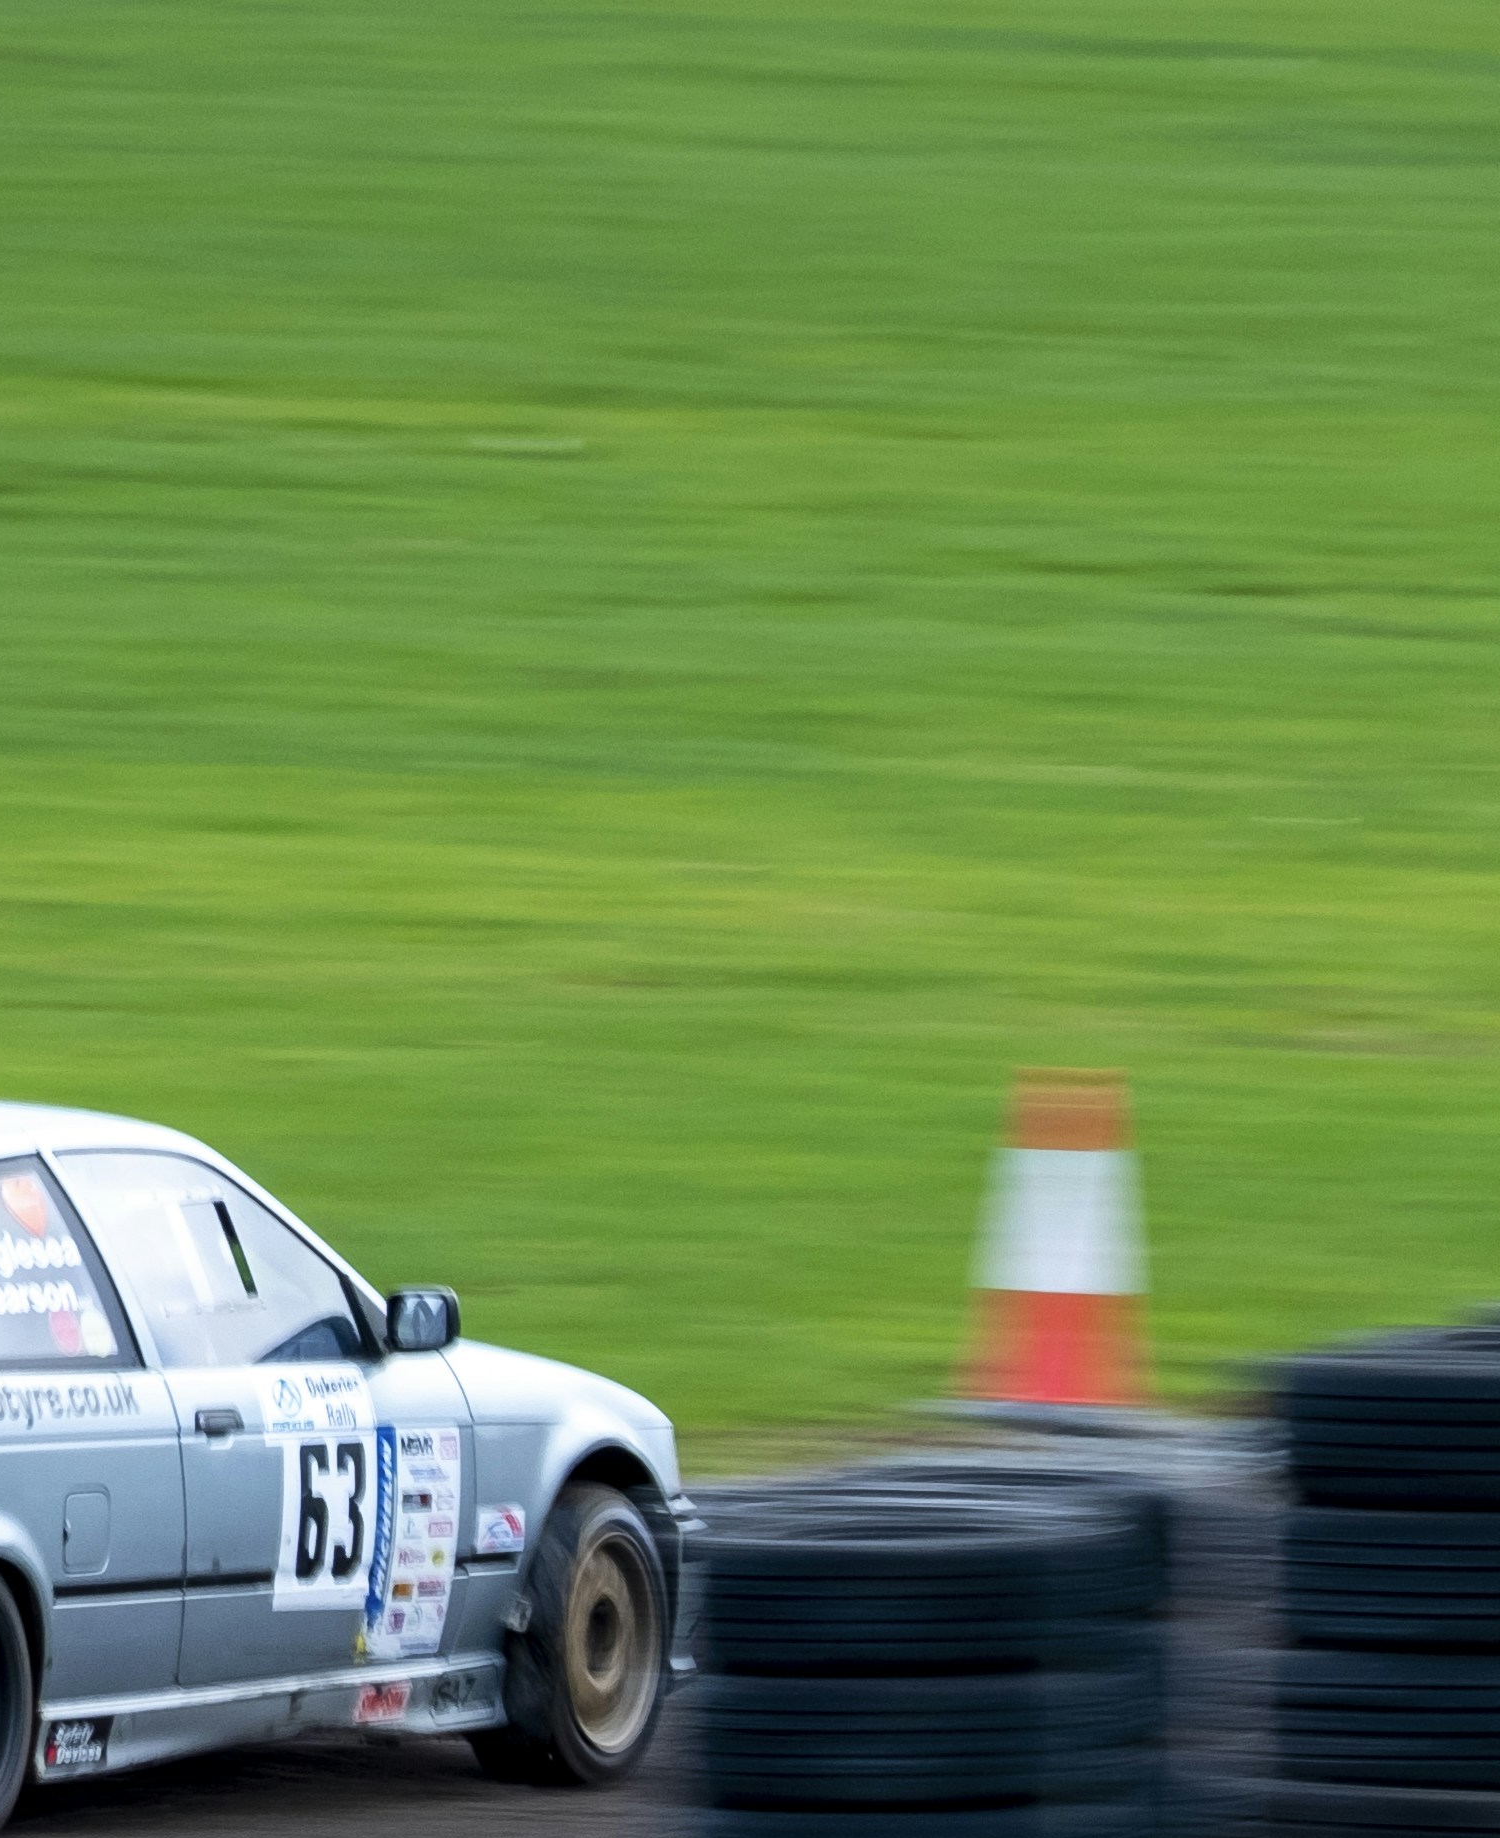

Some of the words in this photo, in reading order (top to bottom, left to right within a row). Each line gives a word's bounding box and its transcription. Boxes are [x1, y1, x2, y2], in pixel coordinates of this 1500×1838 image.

[326, 1402, 357, 1431] Rally
[296, 1440, 366, 1586] 63
[369, 1436, 393, 1601] MICHELIN
[56, 1722, 95, 1745] Safety
[56, 1741, 103, 1765] Devices
